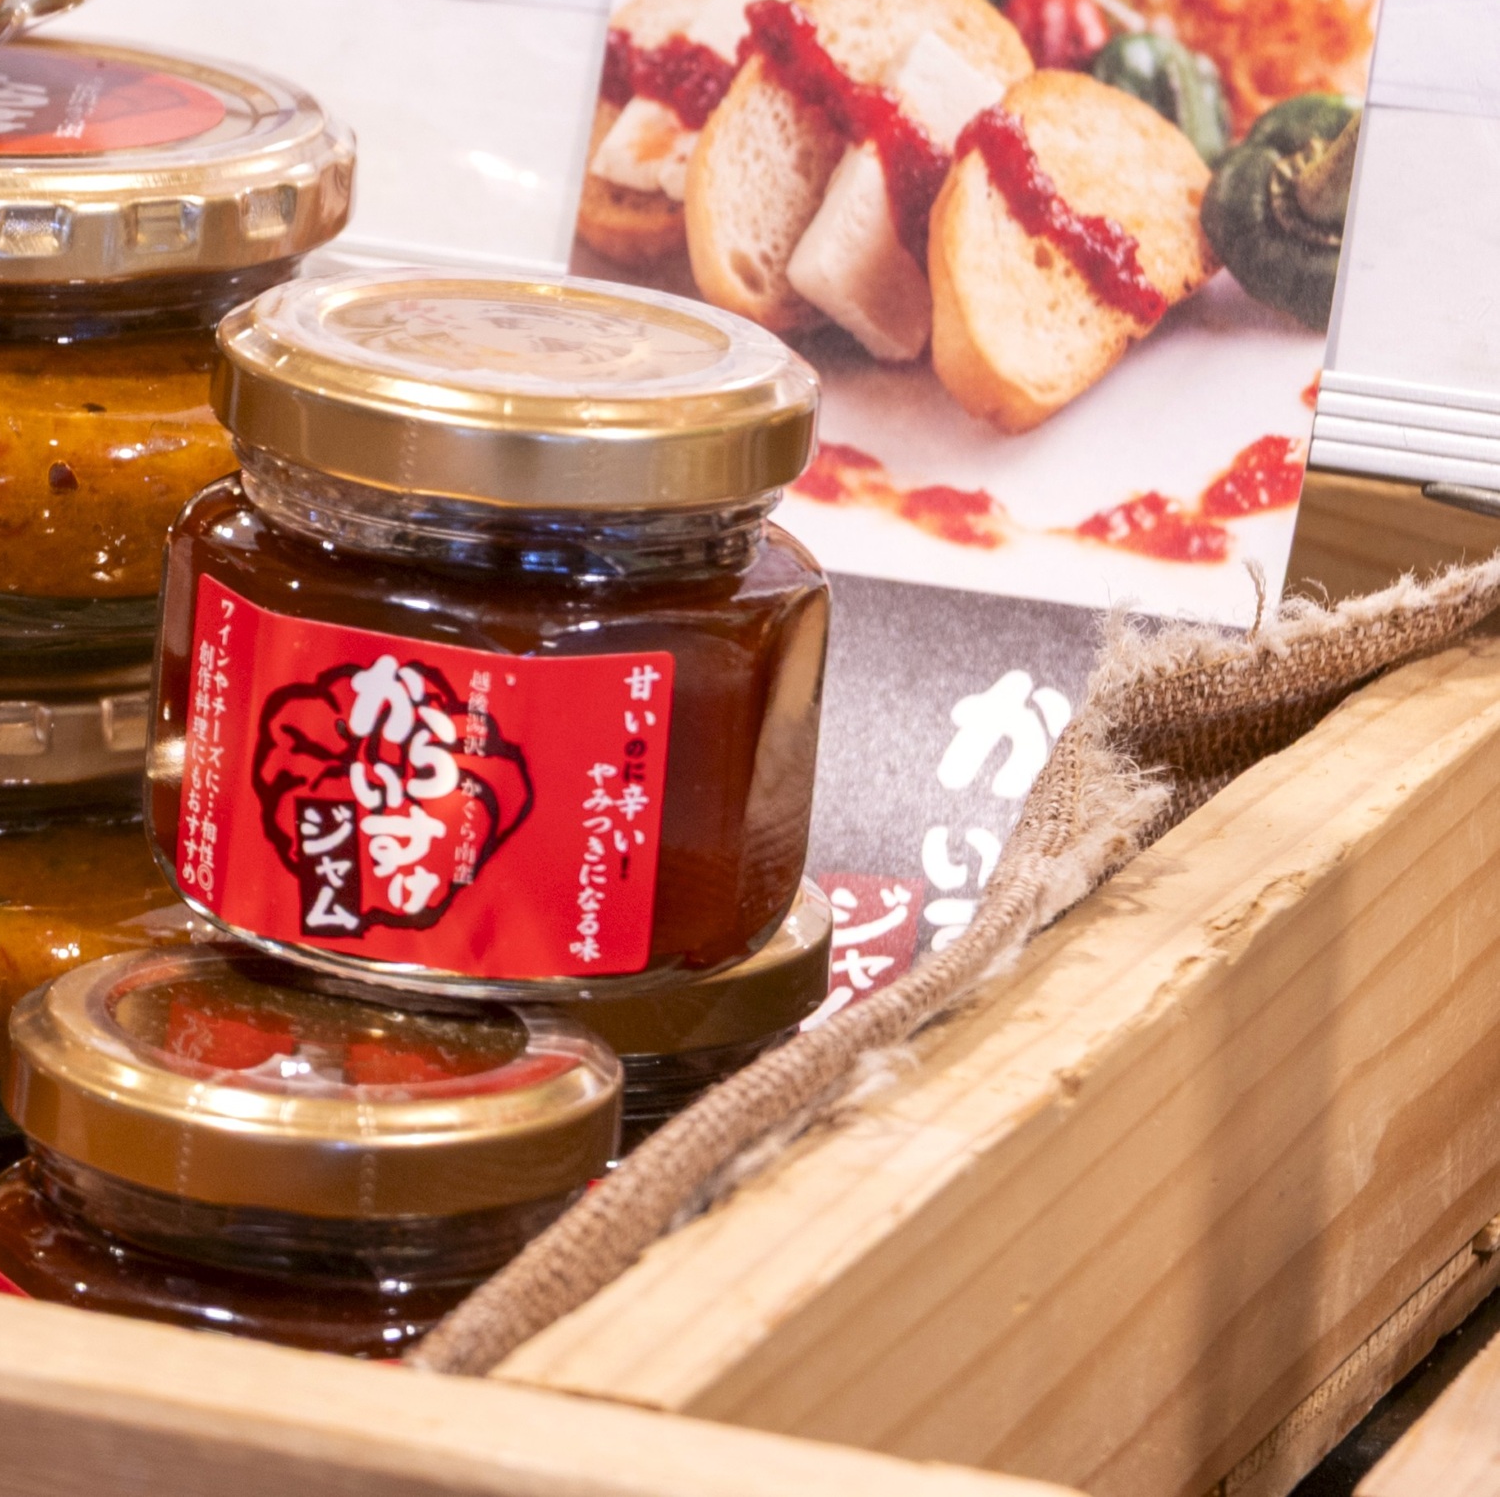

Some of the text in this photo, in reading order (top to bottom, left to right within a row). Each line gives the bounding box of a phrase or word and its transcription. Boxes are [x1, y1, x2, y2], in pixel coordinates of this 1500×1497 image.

[300, 806, 360, 931] ジャム
[349, 654, 460, 915] からいすけ
[568, 761, 619, 963] やみつきになる味
